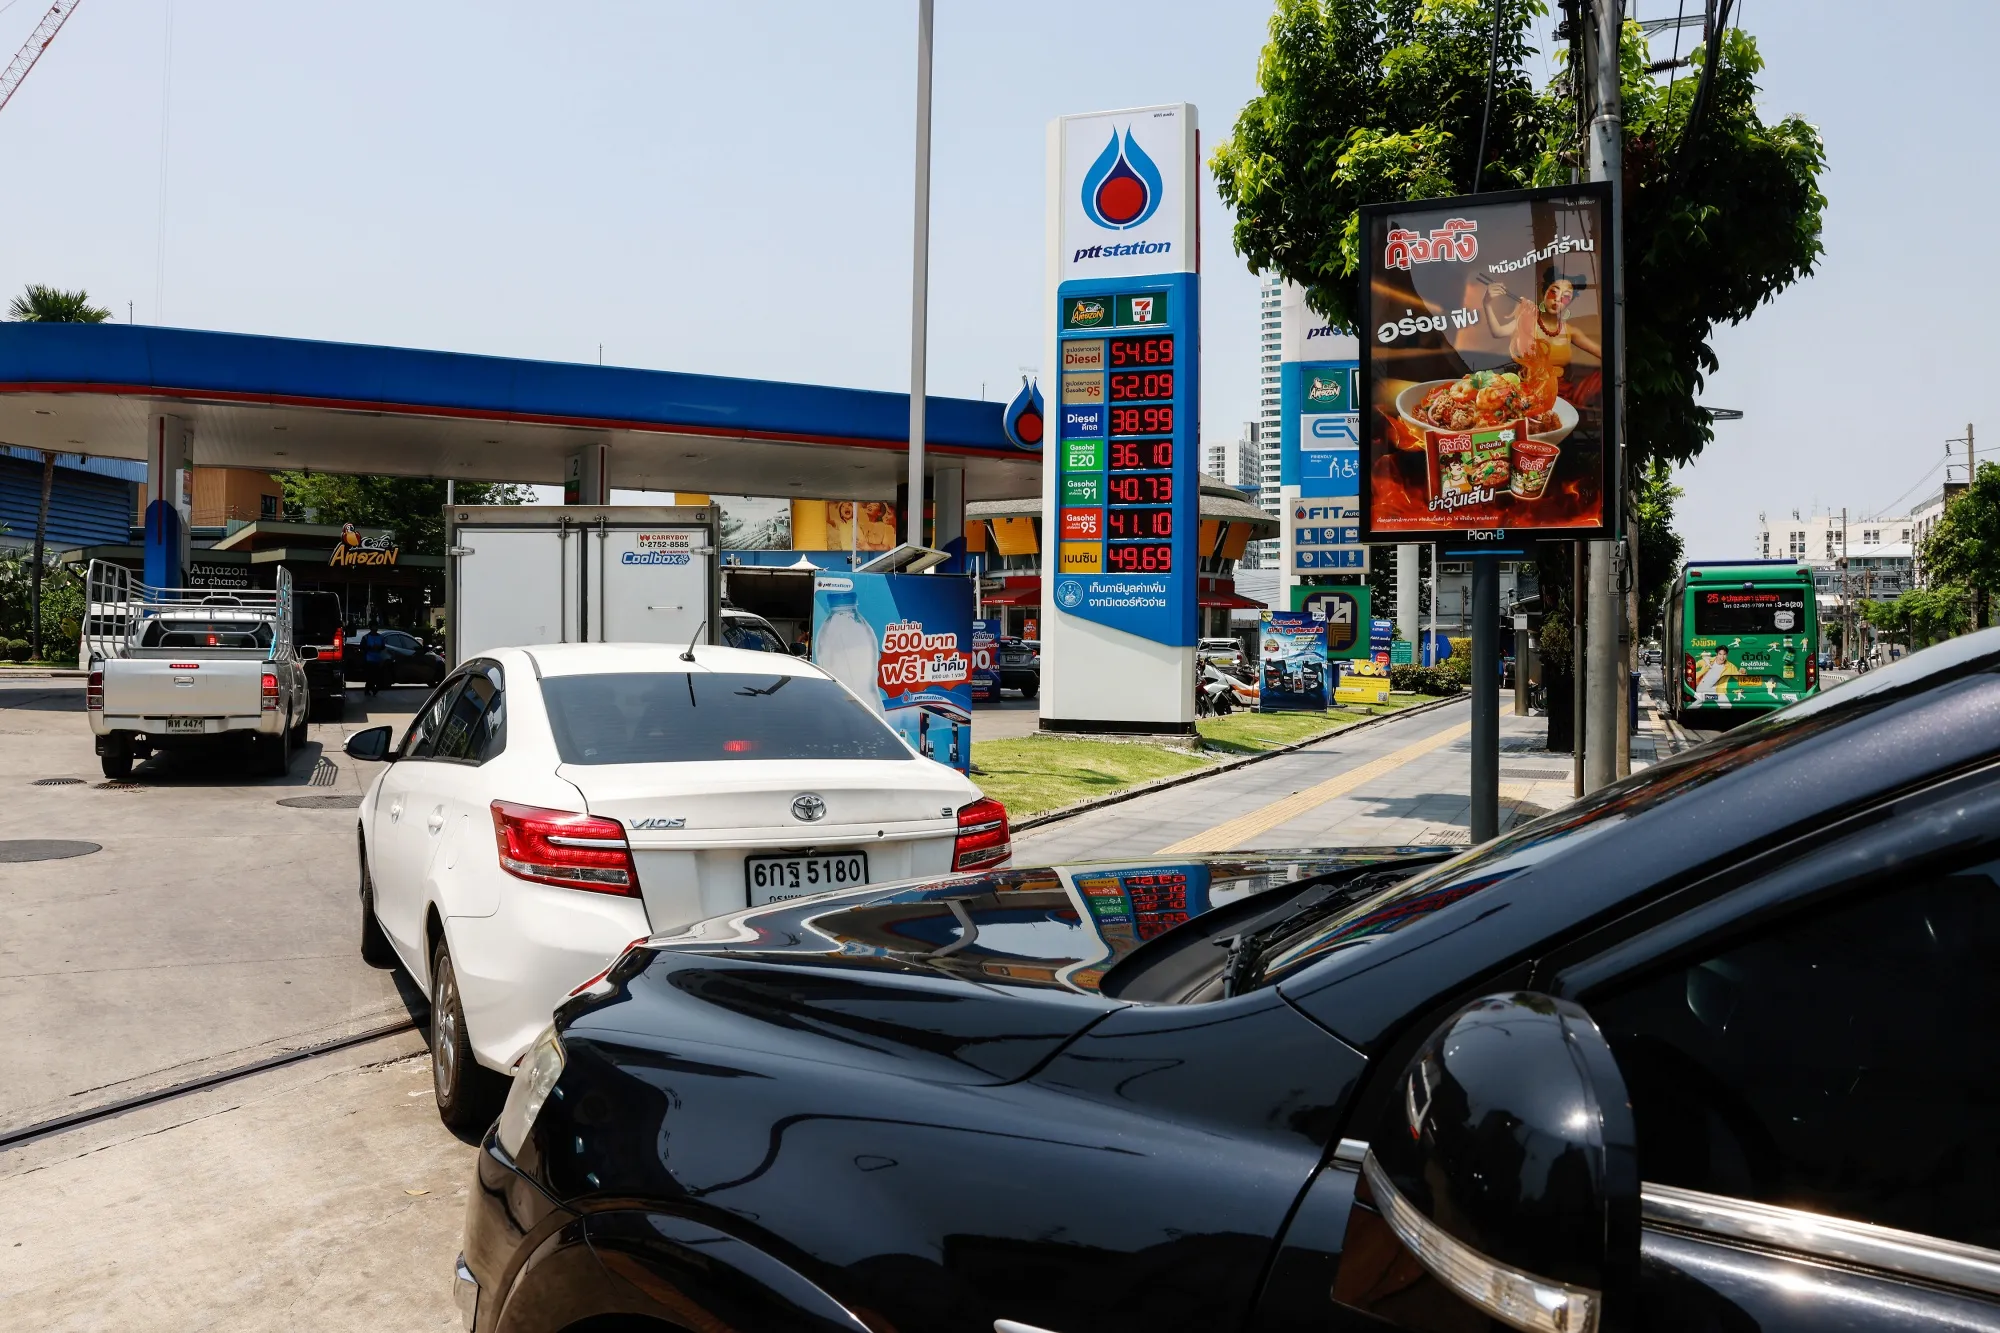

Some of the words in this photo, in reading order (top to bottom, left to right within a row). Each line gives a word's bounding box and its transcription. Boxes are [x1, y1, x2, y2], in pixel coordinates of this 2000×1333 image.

[1488, 235, 1594, 274] เหมือนกินที่ร้าน
[1377, 309, 1448, 343] อร่อย
[1450, 307, 1479, 330] ฟิน
[1065, 352, 1101, 364] Diesel
[1111, 339, 1173, 365] 54.69
[1086, 386, 1101, 397] 95
[1111, 373, 1173, 398] 52.09
[1067, 412, 1098, 424] Diesel
[1112, 408, 1173, 433] 38.99
[1081, 422, 1098, 431] ดีเซล
[1069, 454, 1095, 467] E20
[1112, 442, 1172, 467] 36.10
[1067, 480, 1097, 488] Gasohol
[1110, 477, 1172, 501] 40.73
[1082, 488, 1097, 499] 91
[1428, 485, 1495, 512] ยำวุ้นเส้น
[1066, 513, 1096, 522] Gasohol
[1308, 506, 1344, 520] FIT
[1080, 522, 1097, 533] 95
[1110, 512, 1172, 535] 41.10
[621, 552, 680, 565] Coolbox
[1064, 552, 1098, 564] เบนซิน
[1109, 547, 1172, 570] 49.69
[190, 563, 248, 576] Amazon
[190, 576, 208, 585] for
[209, 576, 248, 586] chance
[1089, 581, 1166, 596] เก็บภาษีมูลค่าเพิ่ม
[1089, 596, 1166, 607] จากมิเตอร์หัวจ่าย
[1707, 593, 1719, 604] 25
[886, 619, 922, 632] เติมน้ำมัน
[884, 632, 922, 651] 500
[925, 634, 955, 648] บาท
[884, 656, 926, 682] ฟรี!
[931, 654, 966, 673] น้ำดื่ม
[629, 818, 688, 829] VIOS
[754, 862, 801, 888] 6กฐ
[807, 859, 861, 884] 5180
